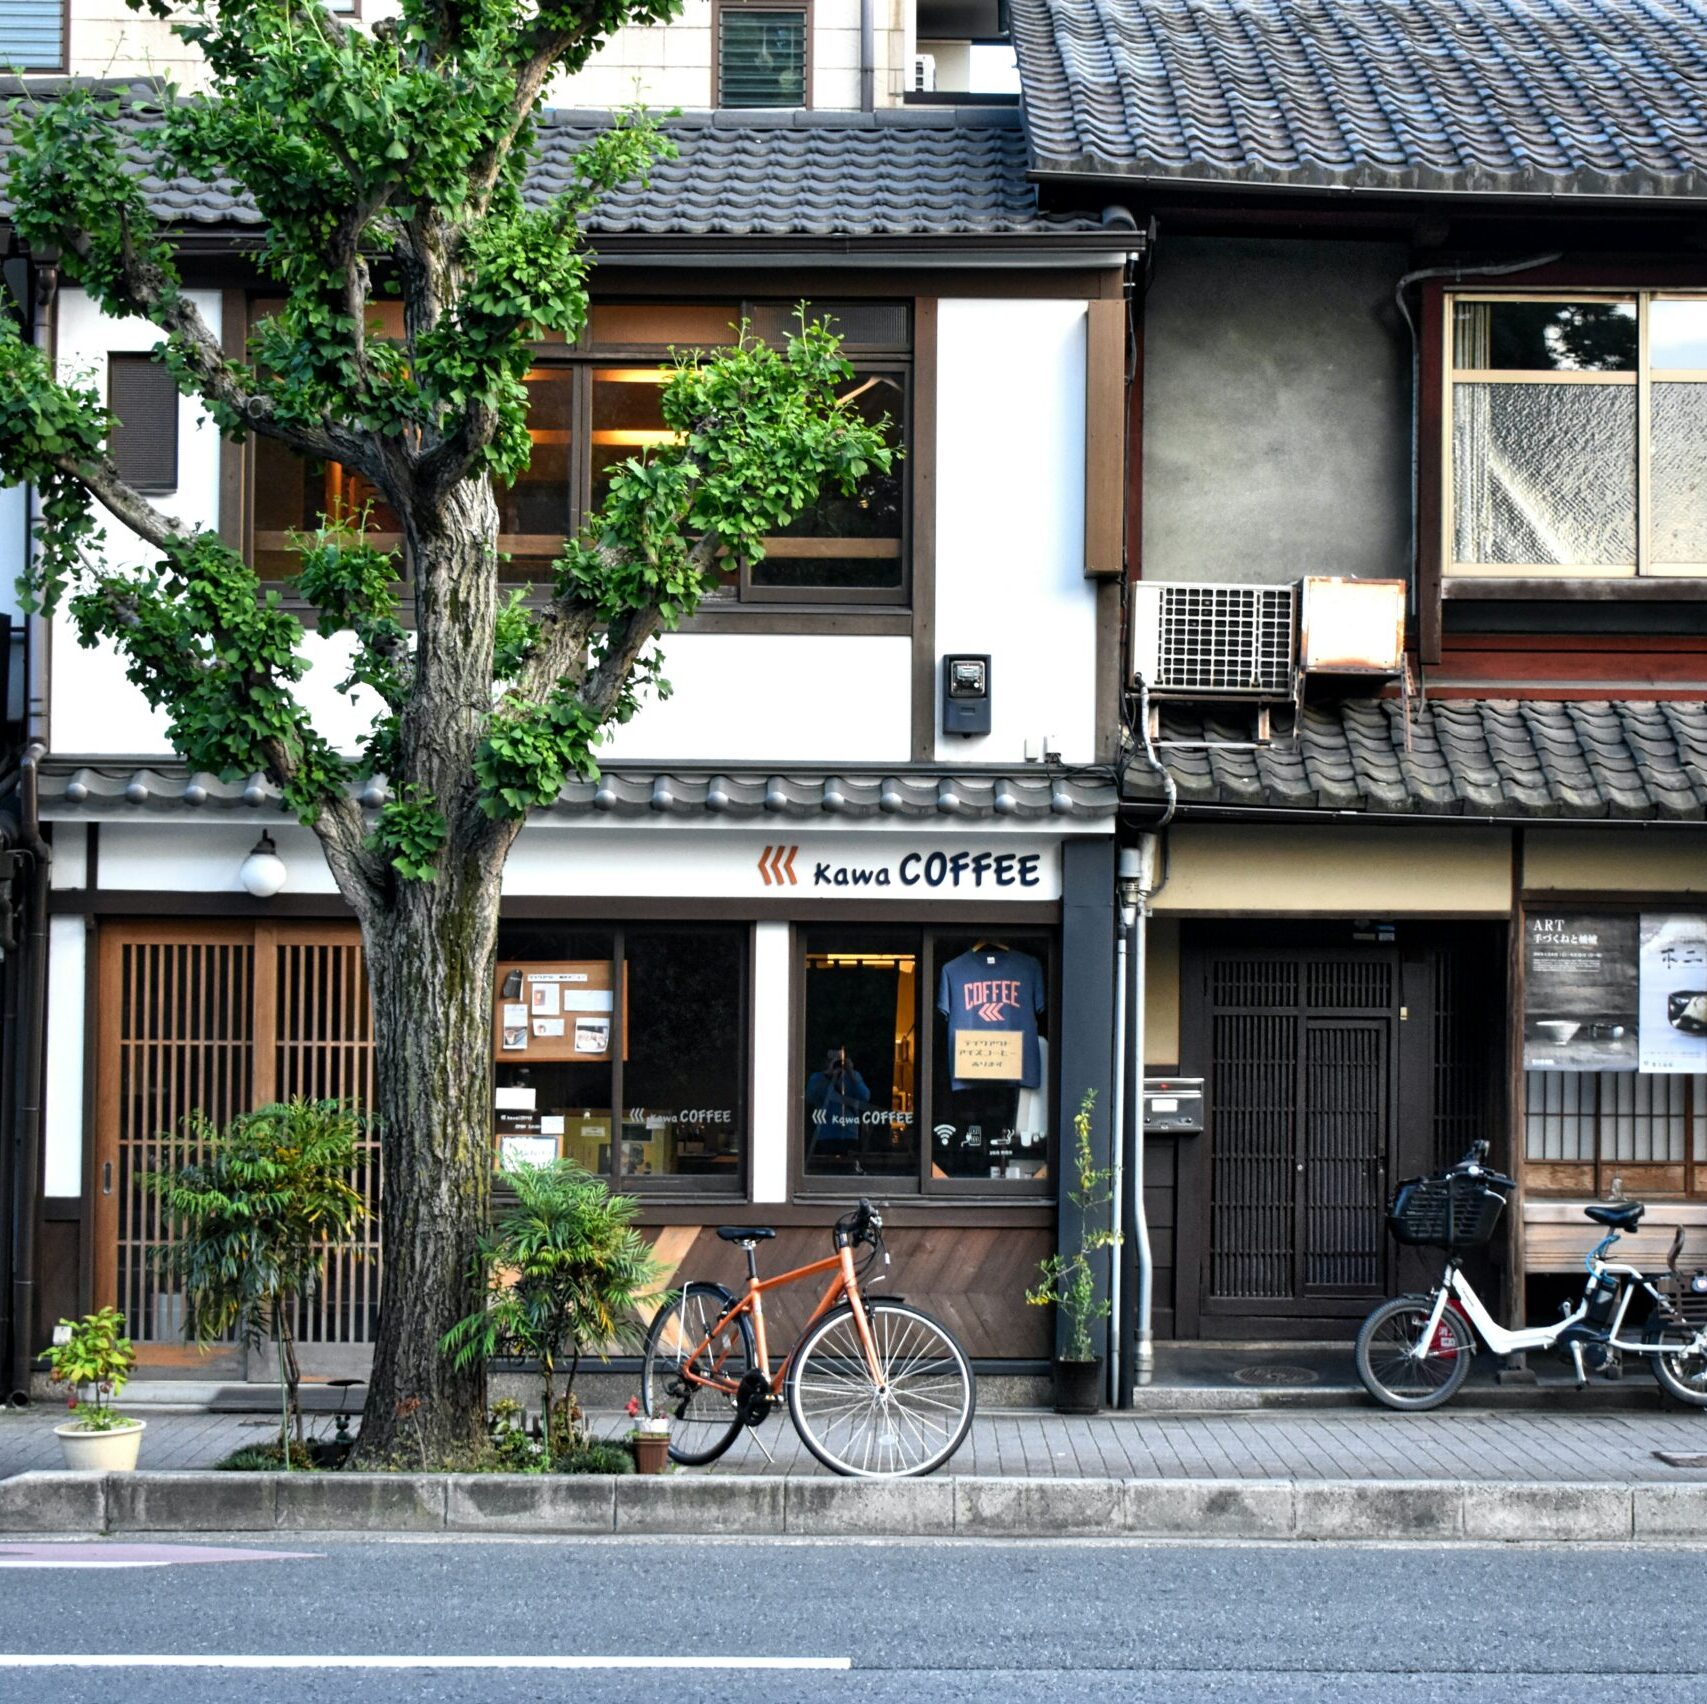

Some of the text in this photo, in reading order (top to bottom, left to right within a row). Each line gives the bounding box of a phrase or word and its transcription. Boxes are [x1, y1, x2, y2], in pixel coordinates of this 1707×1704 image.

[814, 851, 1041, 887] Kawa COFFEE
[1533, 919, 1565, 932] ART
[964, 980, 1021, 1010] COFFEE
[680, 1110, 731, 1123] COFFEE
[831, 1111, 914, 1125] Kawa COFFEE
